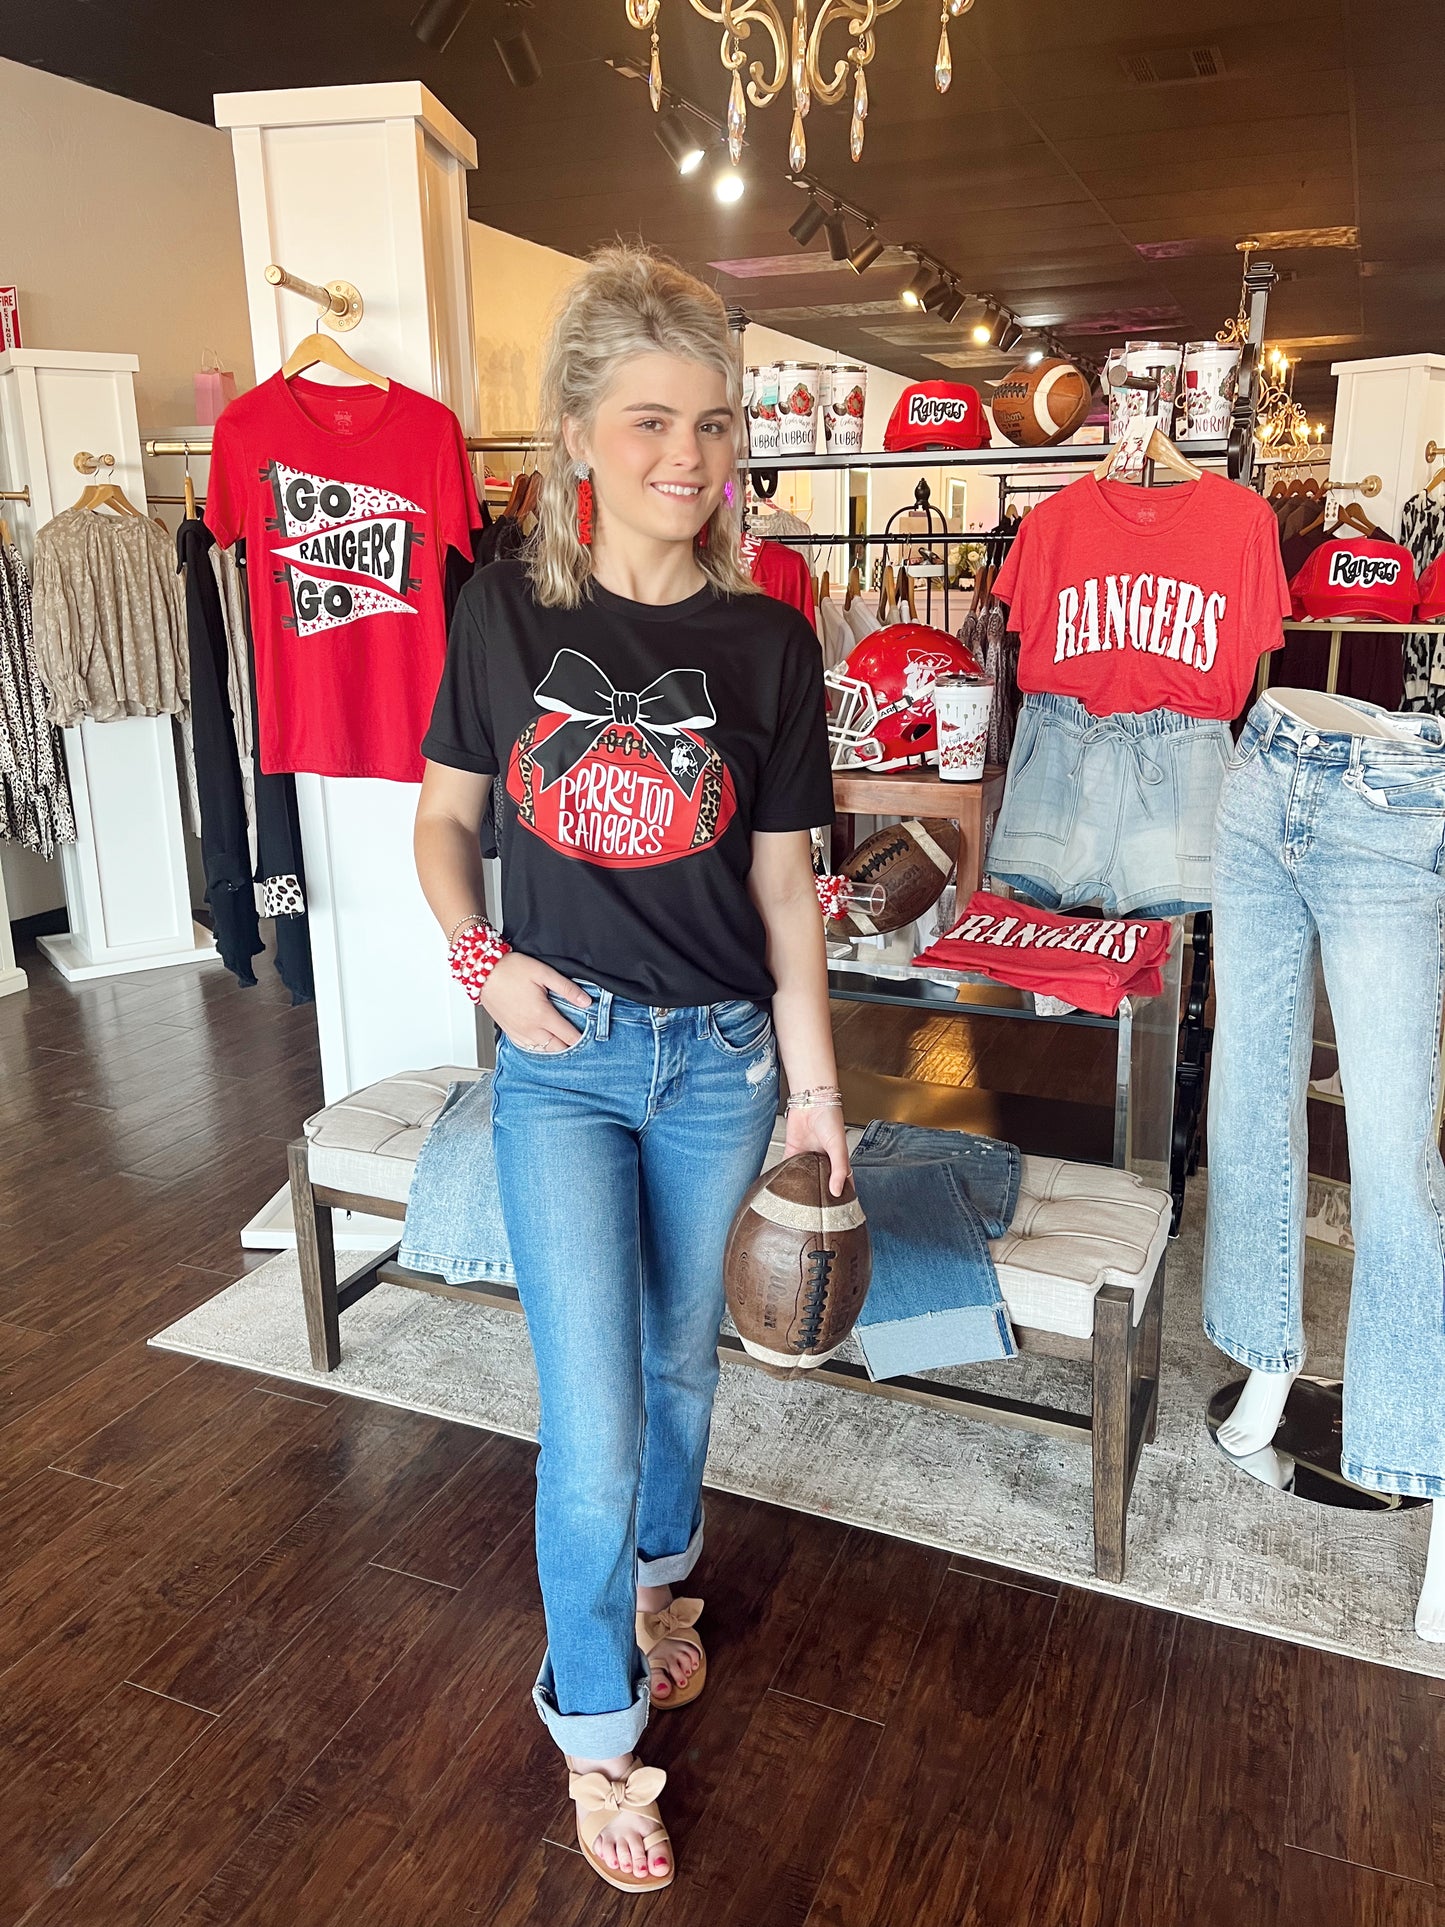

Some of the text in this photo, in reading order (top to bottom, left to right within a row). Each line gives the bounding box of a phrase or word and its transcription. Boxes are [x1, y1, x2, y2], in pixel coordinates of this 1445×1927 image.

[4, 308, 12, 348] EXTINGUI
[911, 396, 967, 424] Rangers
[752, 431, 780, 449] LUBBOC
[781, 429, 814, 445] LUBBOC
[285, 478, 352, 522] GO
[299, 522, 397, 580] RANGERS
[1332, 552, 1399, 585] Rangers
[296, 579, 353, 622] GO
[1053, 572, 1227, 675] RANGERS
[944, 912, 1148, 964] RANGERS
